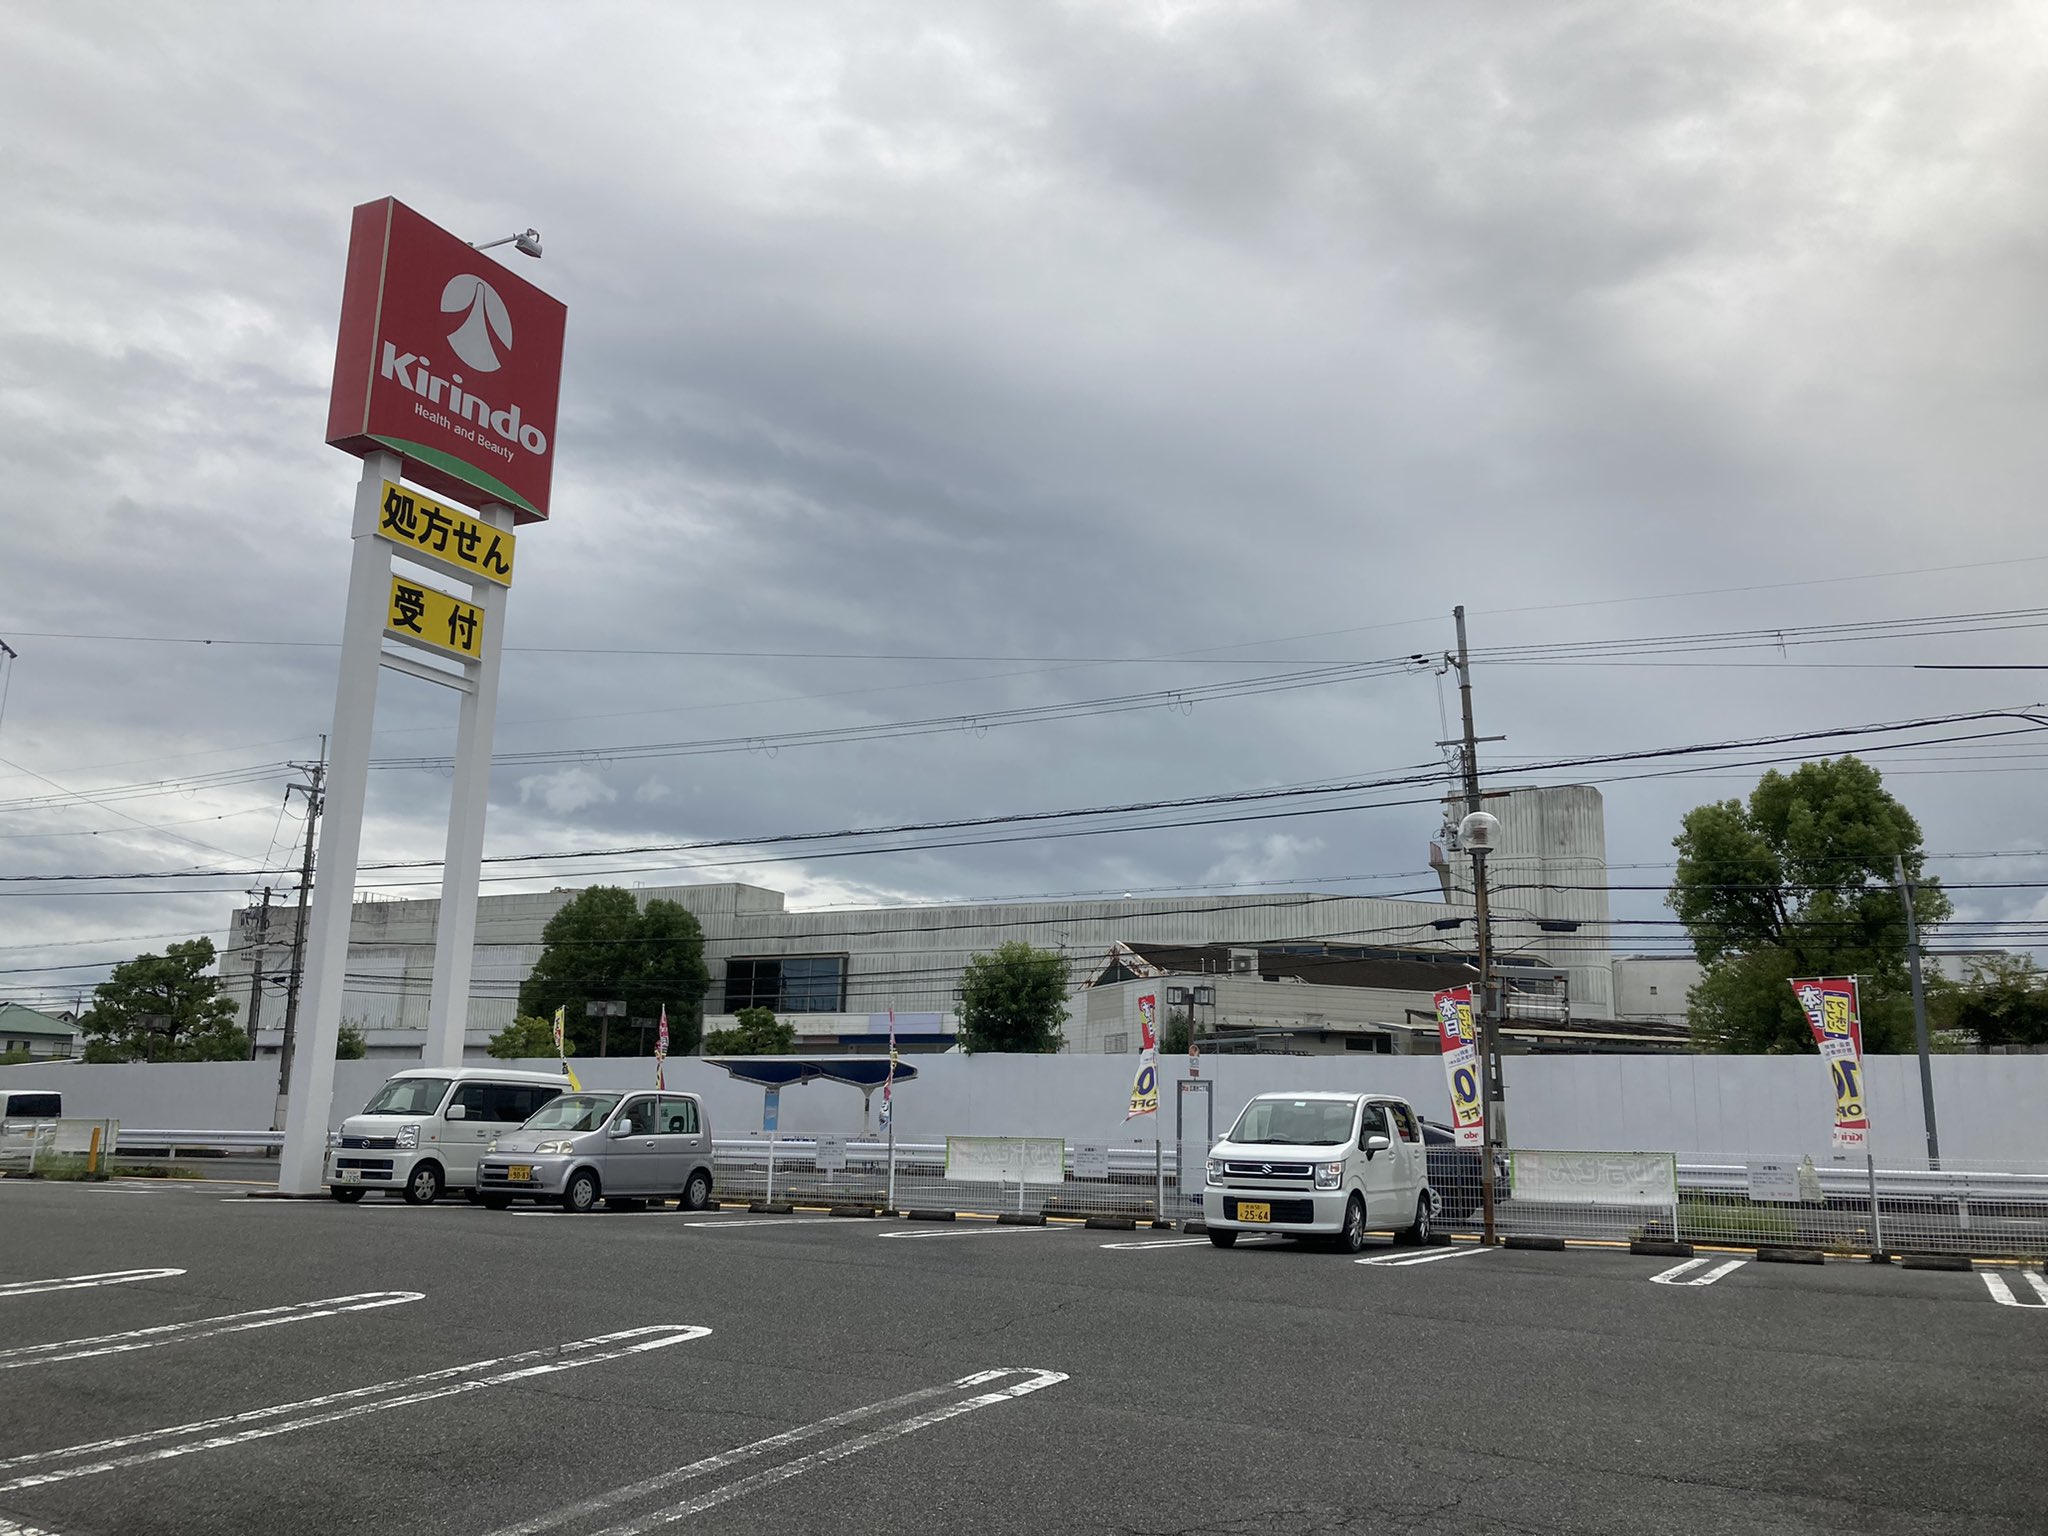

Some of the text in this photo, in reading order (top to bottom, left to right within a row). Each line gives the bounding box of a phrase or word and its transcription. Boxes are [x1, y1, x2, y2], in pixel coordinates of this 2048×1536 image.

[381, 340, 547, 457] Kirindo
[414, 403, 515, 462] Health and Beauty
[382, 486, 510, 576] 処方せん
[393, 584, 477, 651] 受付
